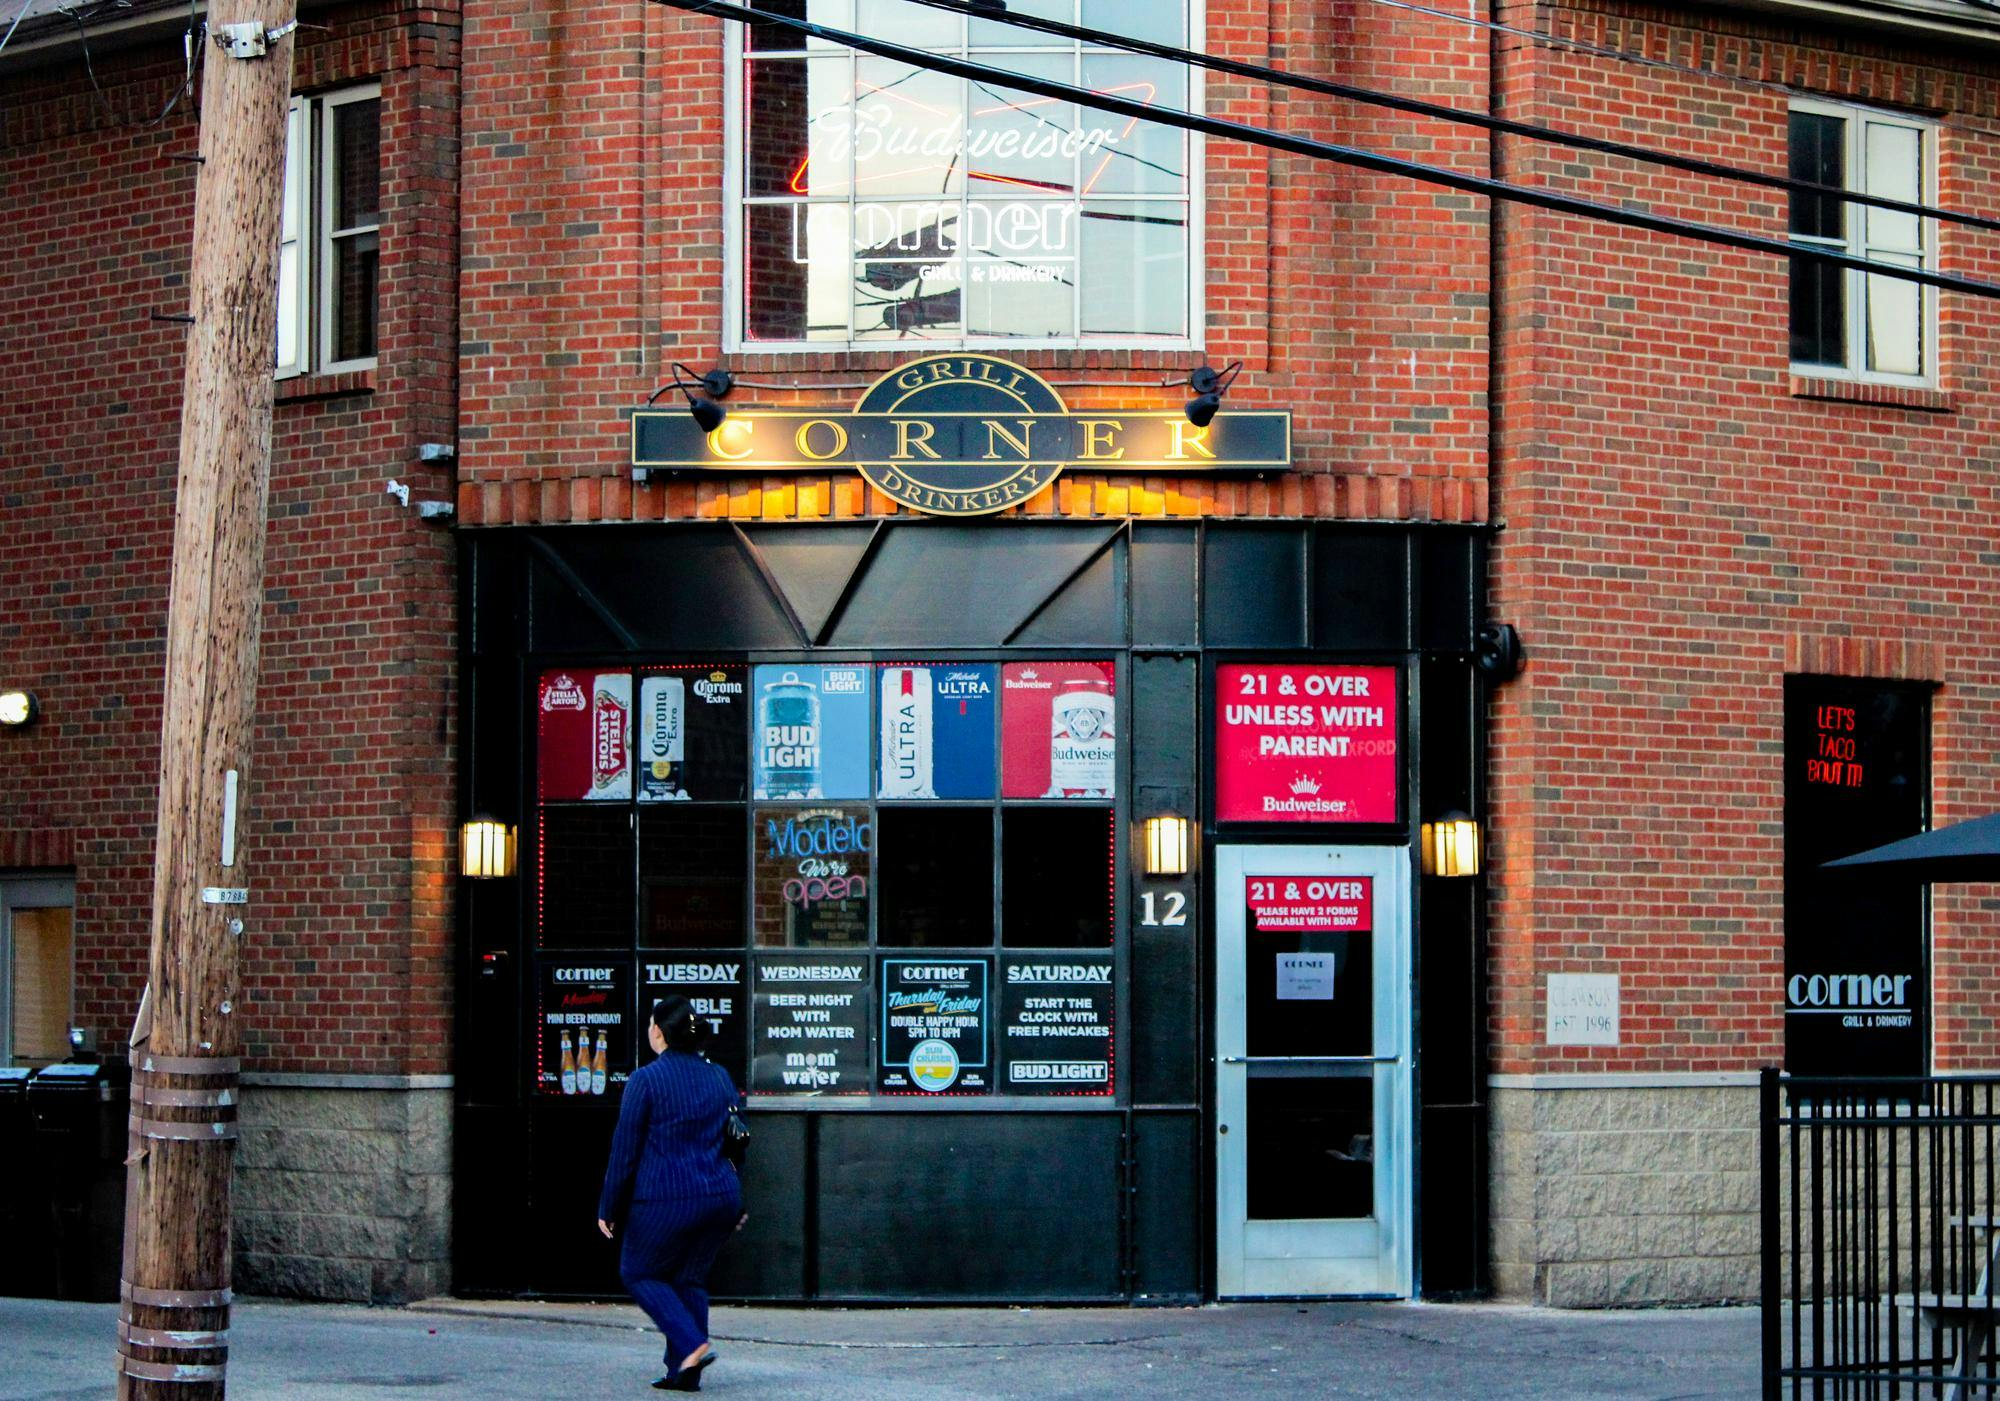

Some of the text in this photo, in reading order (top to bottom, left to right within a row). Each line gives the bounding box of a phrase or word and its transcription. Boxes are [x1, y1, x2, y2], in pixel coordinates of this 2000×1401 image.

[816, 104, 1118, 161] Budweiser
[971, 265, 986, 282] &
[989, 265, 1066, 282] DRINKERY
[897, 361, 1027, 396] GRILL
[707, 419, 1217, 460] CORNER
[880, 468, 1041, 510] DRINKERY
[829, 671, 857, 681] BUD
[1005, 679, 1052, 689] Budweiser
[693, 679, 743, 697] Corona
[824, 681, 861, 691] LIGHT
[938, 681, 990, 694] ULTRA
[1240, 674, 1370, 696] 21 & OVER
[551, 690, 578, 699] STELLA
[551, 698, 578, 706] ARTOIS
[705, 694, 731, 703] Extra
[1225, 704, 1383, 726] UNLESS WITH
[1817, 706, 1855, 731] LET'S
[652, 691, 671, 757] Corona
[668, 707, 678, 740] Extra
[598, 709, 609, 770] ARTOIS
[609, 709, 621, 769] STELLA
[765, 725, 817, 747] BUD
[899, 704, 915, 779] ULTRA
[1052, 745, 1115, 760] Budweise
[1259, 735, 1351, 757] PARENT
[1818, 733, 1856, 760] TACO
[760, 746, 820, 768] LIGHT
[1262, 796, 1347, 812] Budweiser
[797, 858, 848, 877] We're
[783, 875, 867, 910] open
[1251, 882, 1364, 900] 21 & OVER
[1141, 891, 1187, 926] 12
[1256, 906, 1358, 915] PLEASE HAVE 2 FORMS
[1257, 917, 1358, 926] AVAILABLE WITH BDAY
[556, 968, 614, 981] corner
[645, 964, 740, 981] TUESDAY
[761, 966, 862, 979] WEDNESDAY
[902, 967, 969, 980] corner
[1008, 965, 1112, 981] SATURDAY
[1788, 974, 1912, 1006] corner
[653, 998, 732, 1015] BLE
[769, 994, 853, 1006] BEER NIGHT
[888, 988, 981, 1013] Thursday Friday
[1024, 998, 1092, 1009] START THE
[546, 1013, 564, 1024] MINI
[565, 1013, 586, 1024] BEER
[792, 1010, 830, 1022] WITH
[890, 1016, 979, 1027] DOUBLE HAPPY HOUR
[1019, 1012, 1098, 1023] CLOCK WITH
[1554, 1015, 1612, 1032] EST 1996
[1842, 1015, 1912, 1027] GRILL & DRINKERY
[767, 1026, 855, 1038] MOM WATER
[908, 1028, 927, 1038] 5PM
[929, 1028, 940, 1038] TO
[1008, 1026, 1109, 1037] FREE PANCAKES
[916, 1055, 951, 1063] CRUISER
[1013, 1064, 1104, 1079] BUD LIGHT
